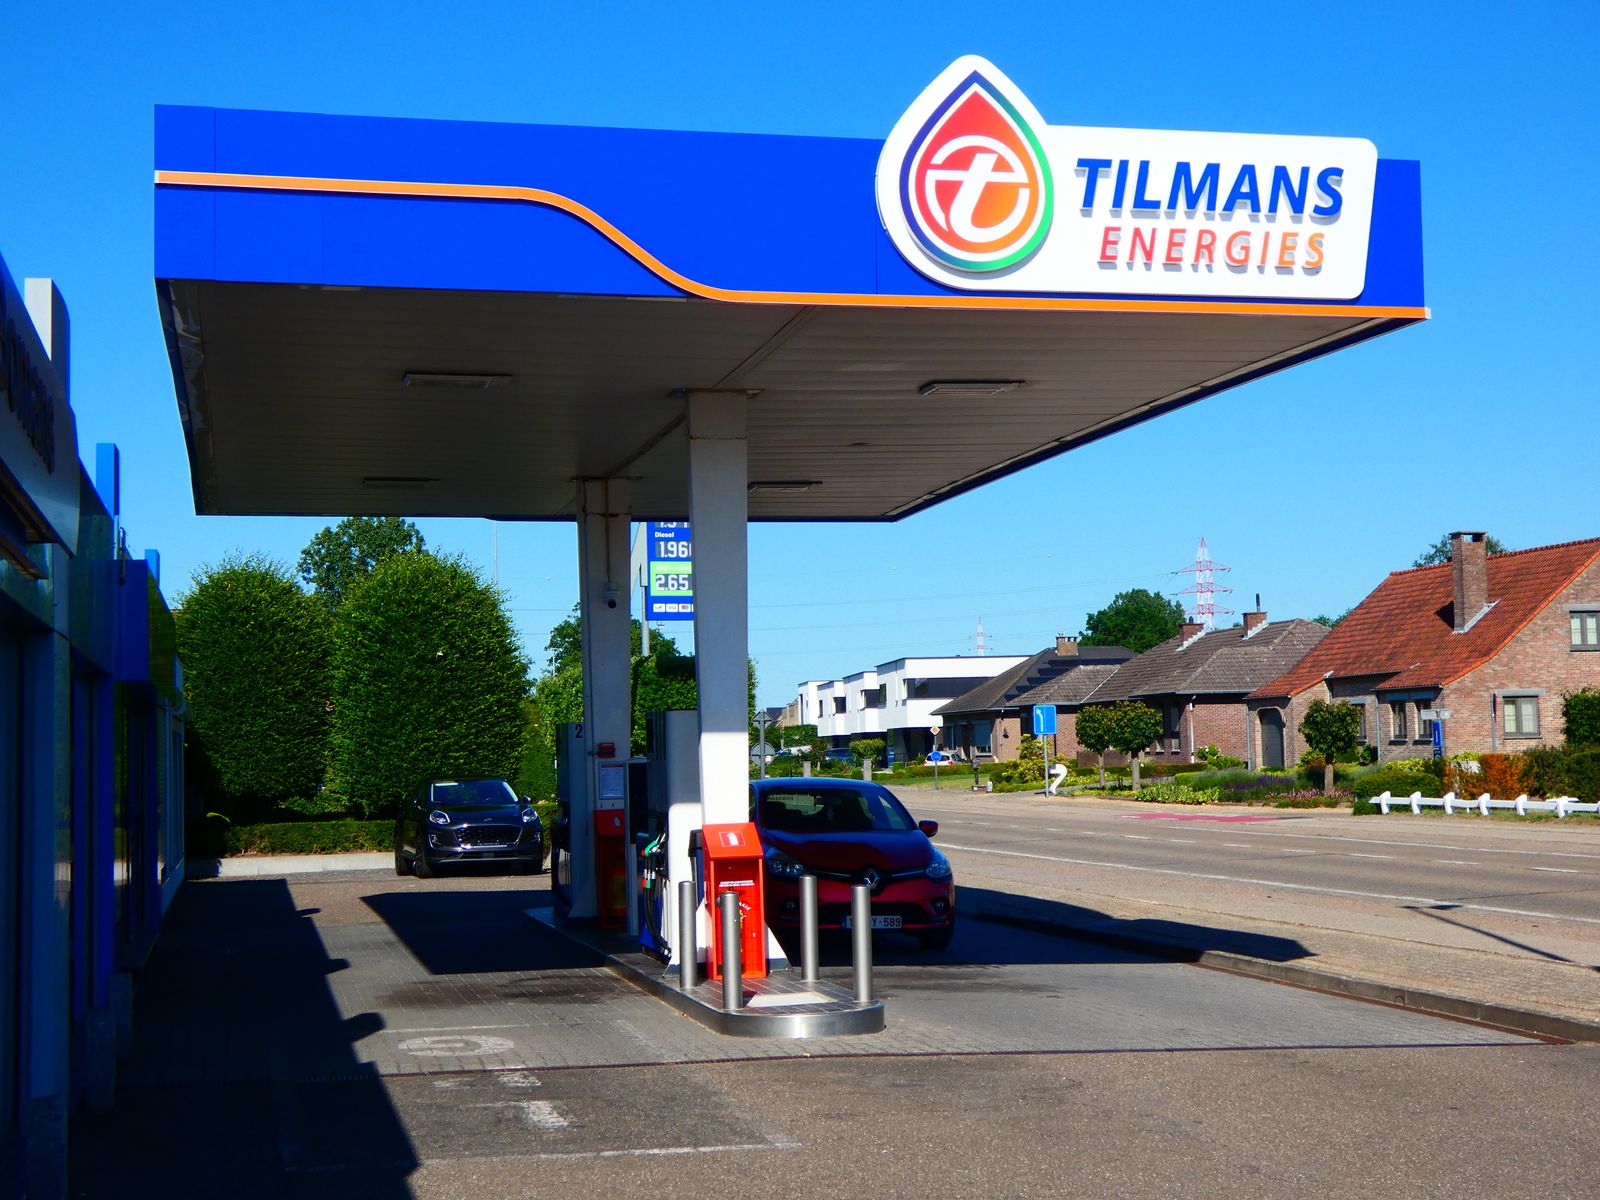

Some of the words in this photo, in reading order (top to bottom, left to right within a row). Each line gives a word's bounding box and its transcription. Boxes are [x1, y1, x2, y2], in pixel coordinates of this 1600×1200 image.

[1076, 157, 1344, 217] TILMANS
[1099, 225, 1325, 268] ENERGIES
[660, 541, 691, 558] 1.96
[575, 723, 583, 738] 2
